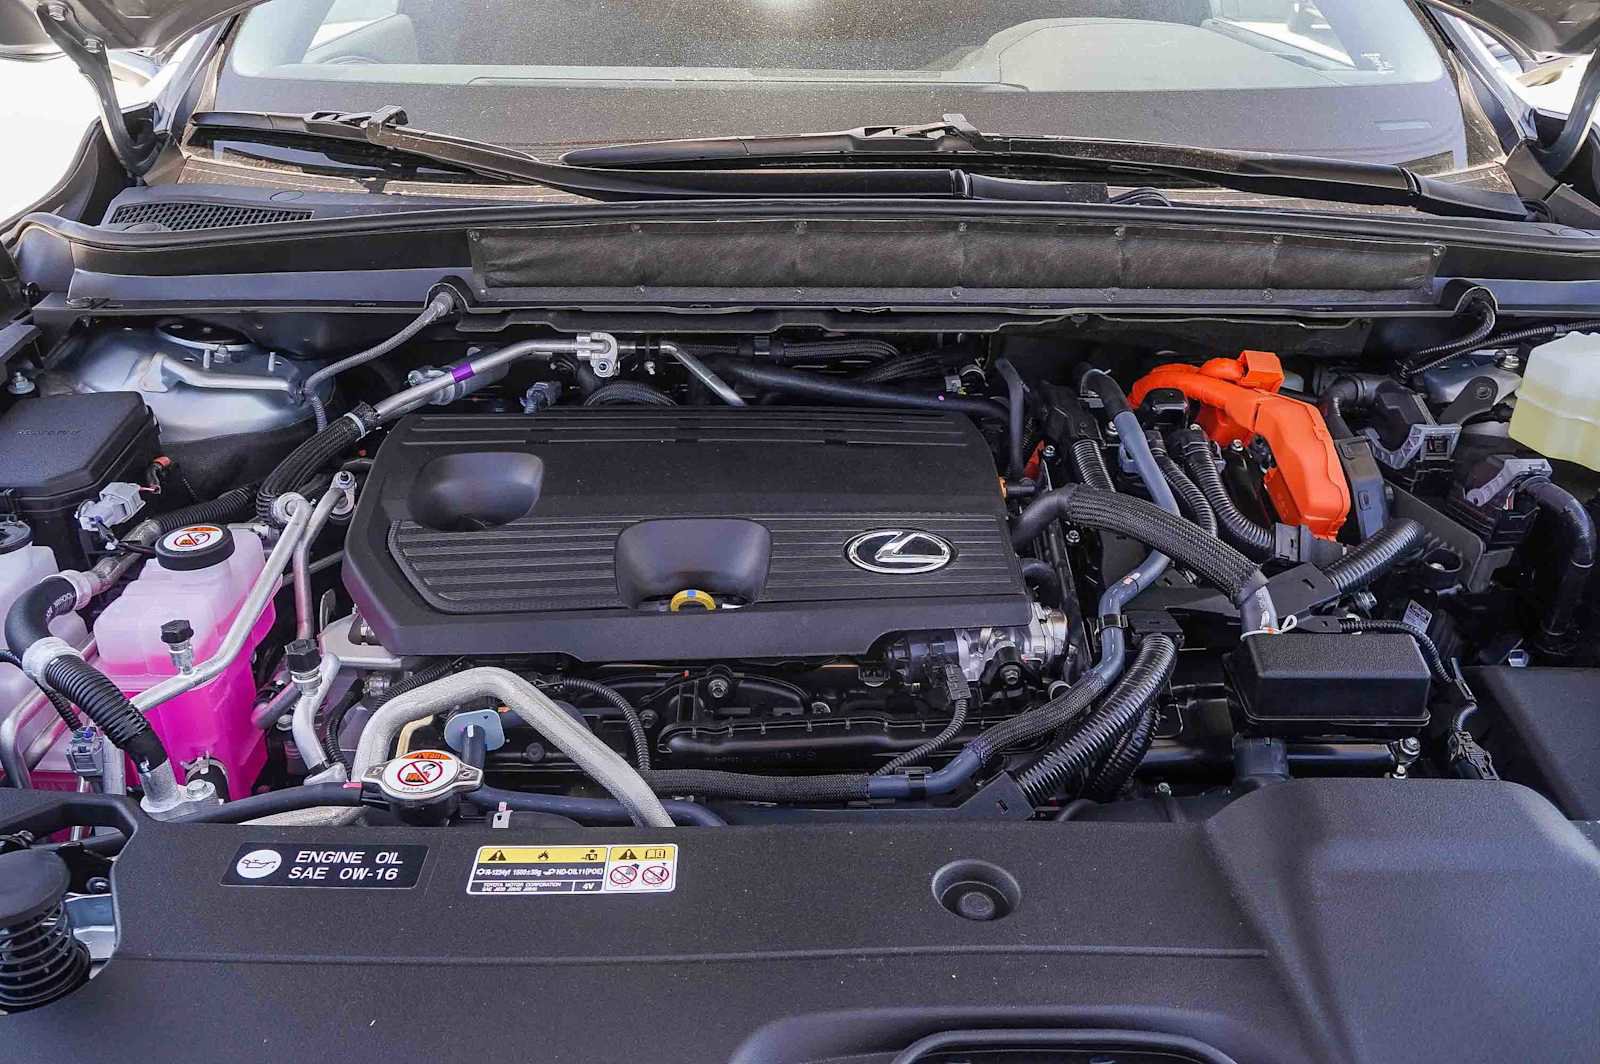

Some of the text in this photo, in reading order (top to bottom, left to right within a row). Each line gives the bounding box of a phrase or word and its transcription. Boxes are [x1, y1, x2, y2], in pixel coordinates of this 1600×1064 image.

[295, 851, 403, 864] ENGINE OIL
[288, 867, 329, 879] SAE
